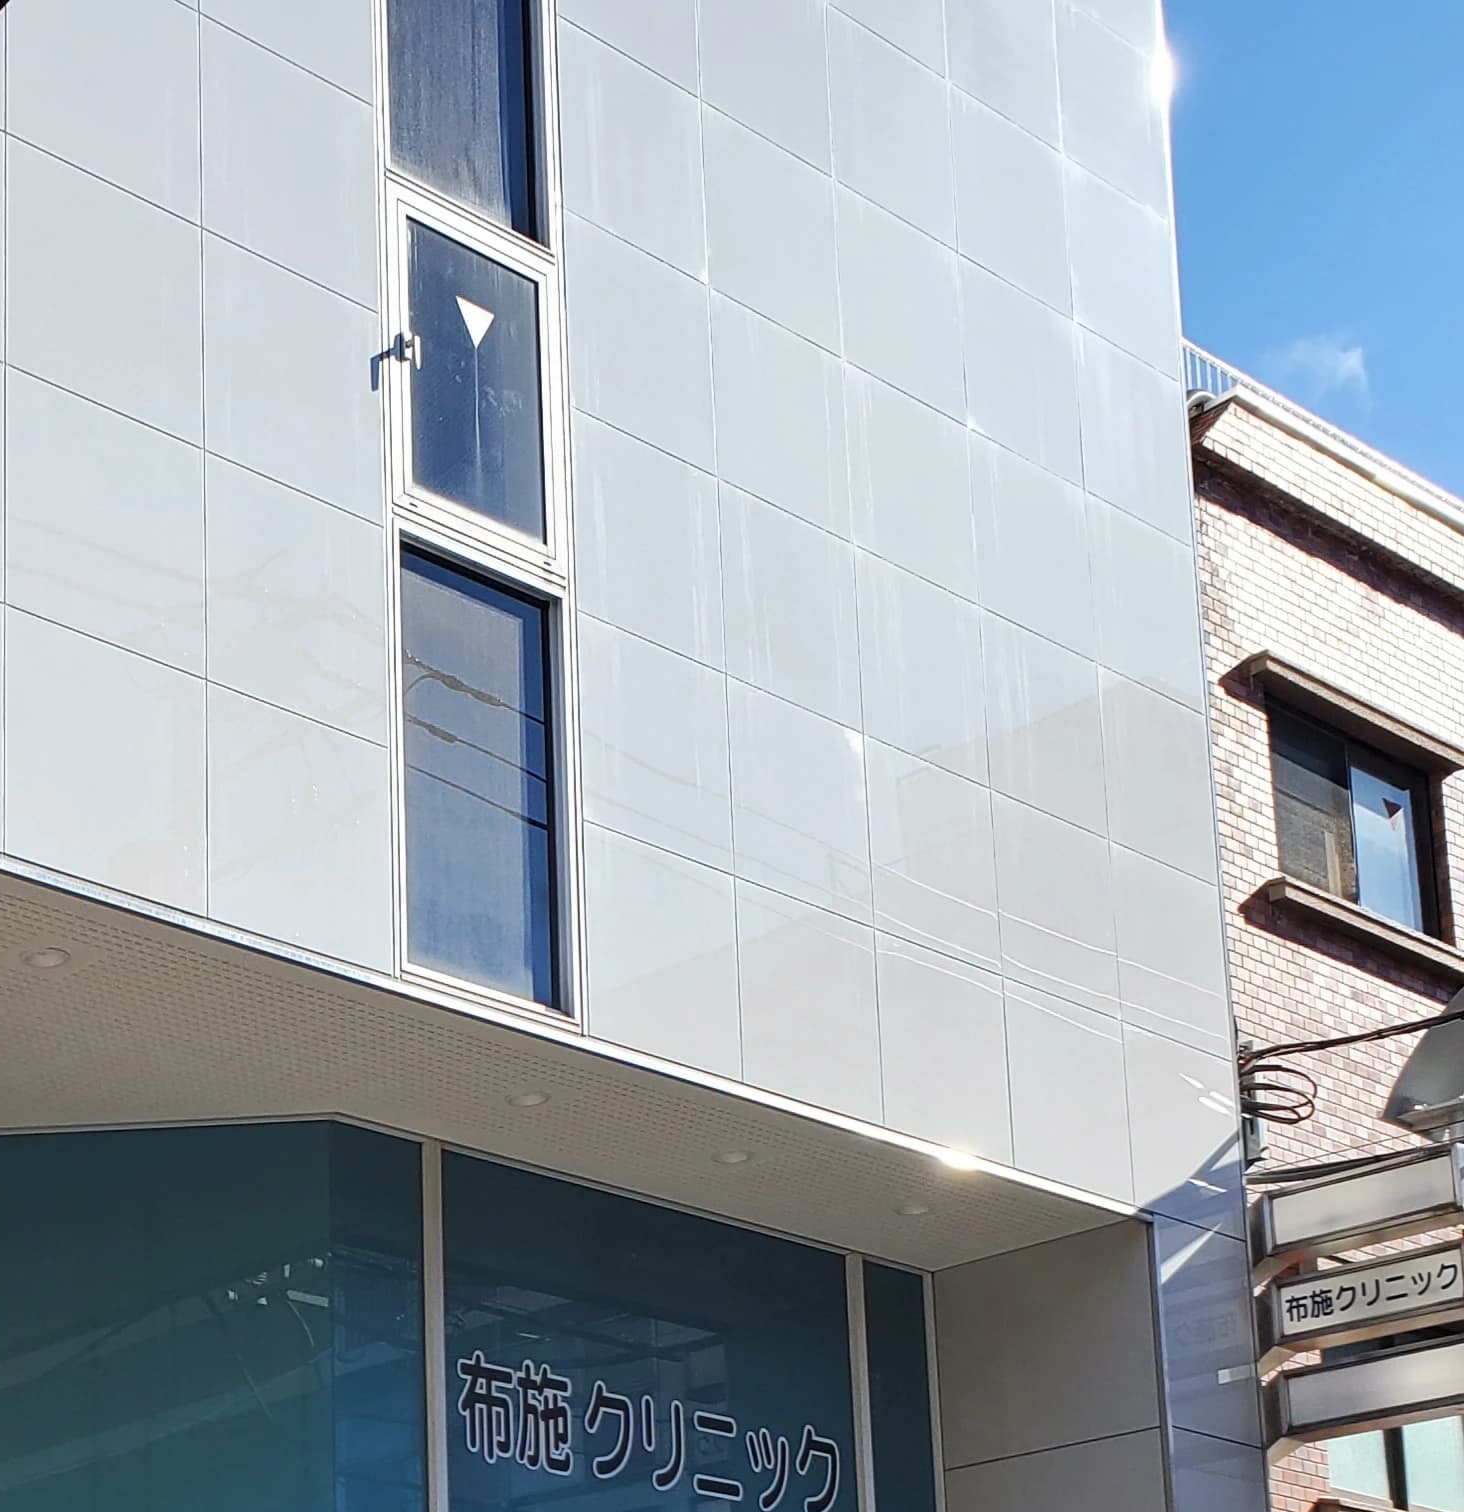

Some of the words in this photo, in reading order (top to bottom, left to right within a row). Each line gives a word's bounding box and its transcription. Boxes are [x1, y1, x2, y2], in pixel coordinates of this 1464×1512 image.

[1285, 1263, 1458, 1323] 布施クリニック
